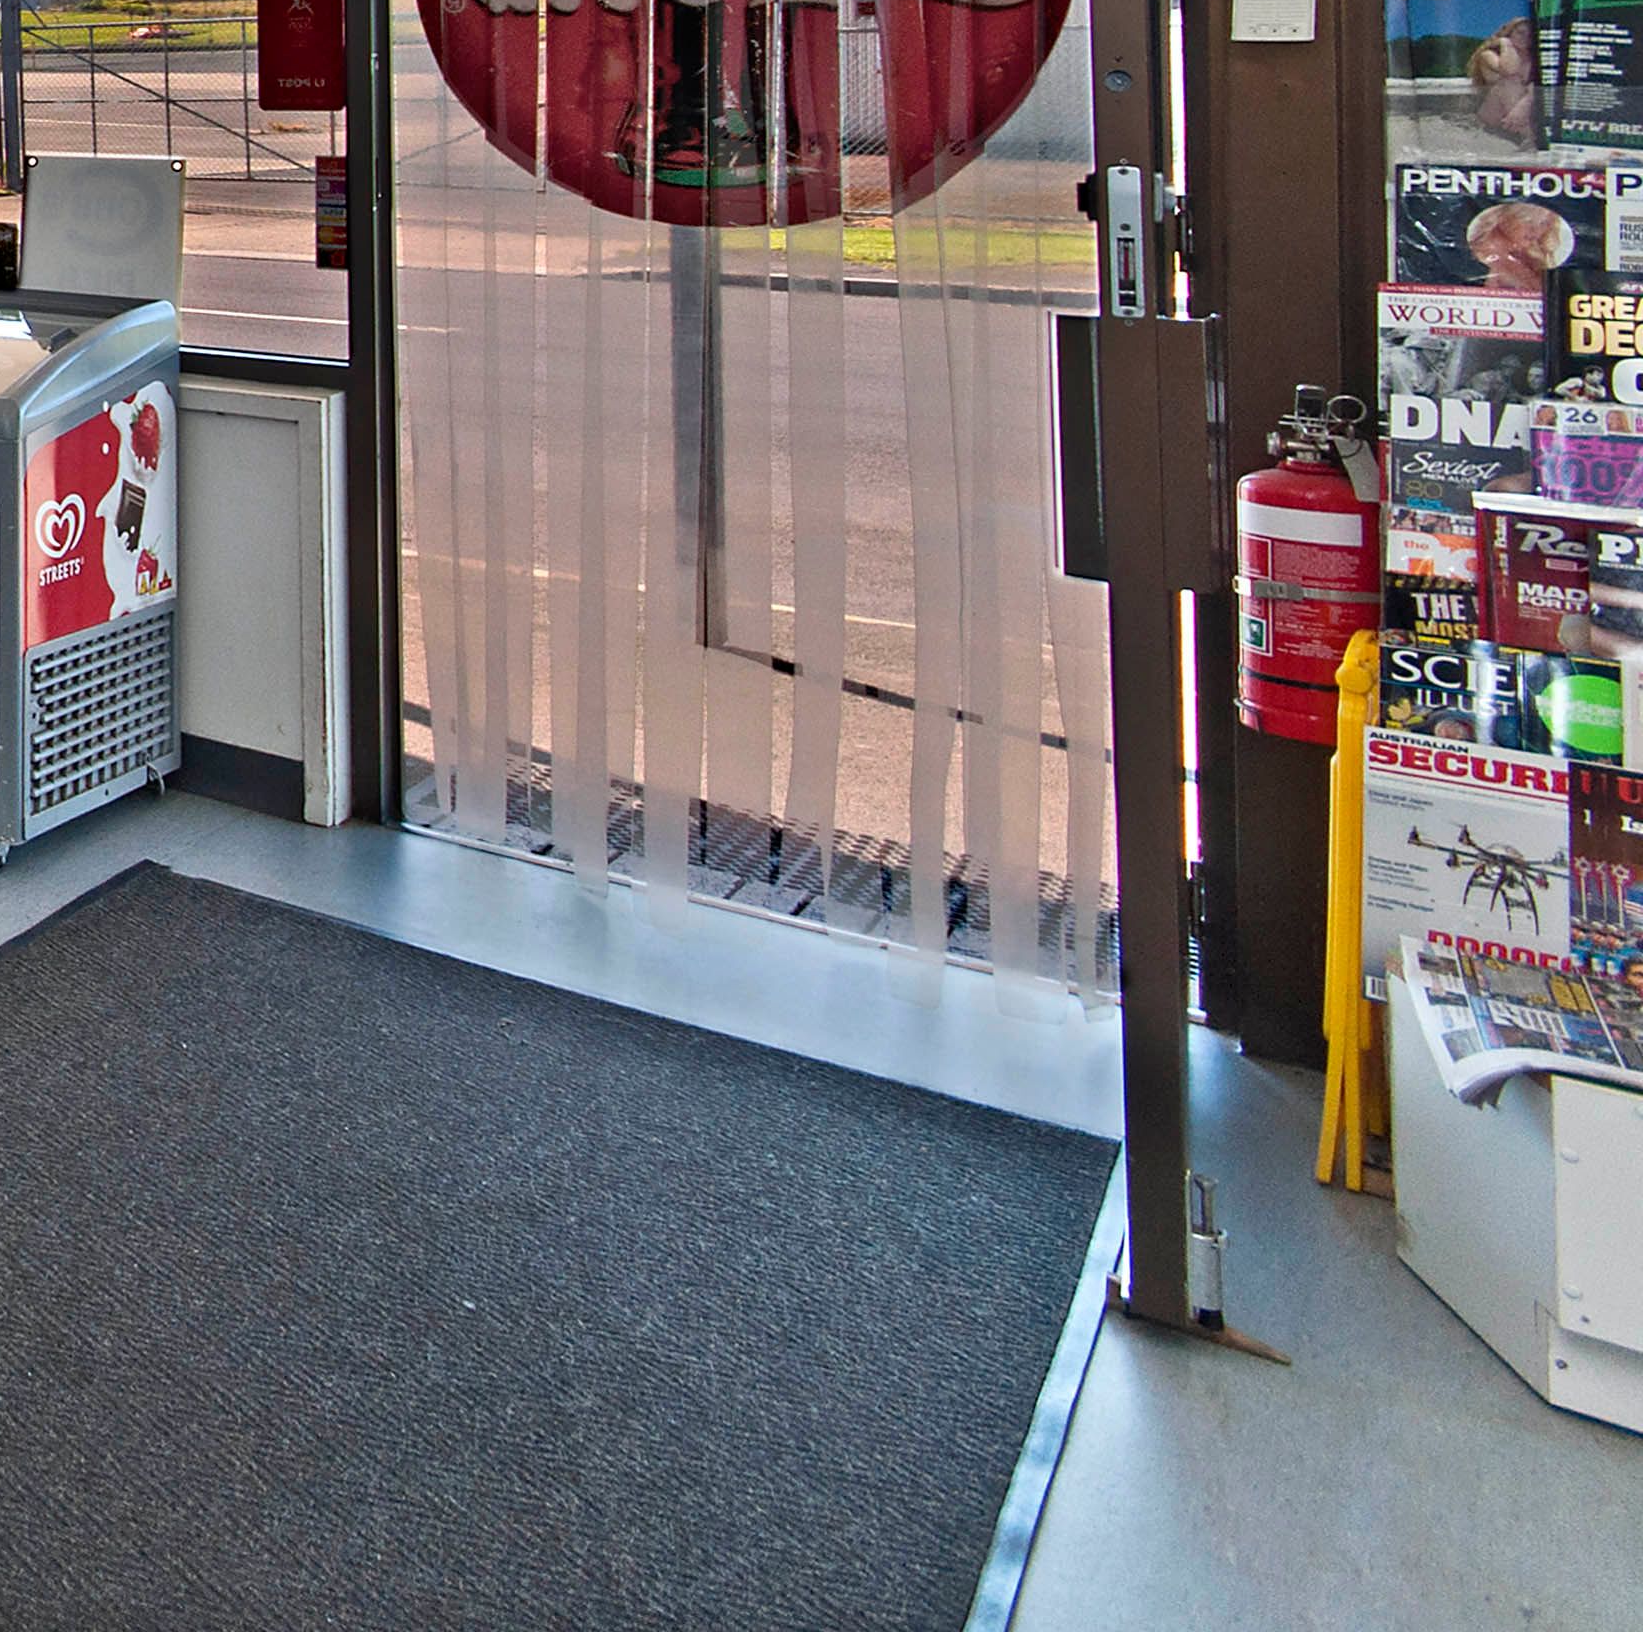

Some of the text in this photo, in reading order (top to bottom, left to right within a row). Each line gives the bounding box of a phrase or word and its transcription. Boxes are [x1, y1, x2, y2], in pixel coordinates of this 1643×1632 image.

[1388, 304, 1515, 329] WORLD
[1390, 394, 1531, 451] DNA
[1565, 407, 1599, 424] 26
[1402, 451, 1501, 481] Sexiest
[39, 557, 81, 587] STREETS
[1411, 592, 1467, 621] THE
[1518, 581, 1589, 602] MAD
[1390, 649, 1515, 698] SCIE
[1416, 687, 1516, 717] ILLUST
[1369, 731, 1470, 754] AUSTRALIAN
[1368, 739, 1570, 795] SECURI
